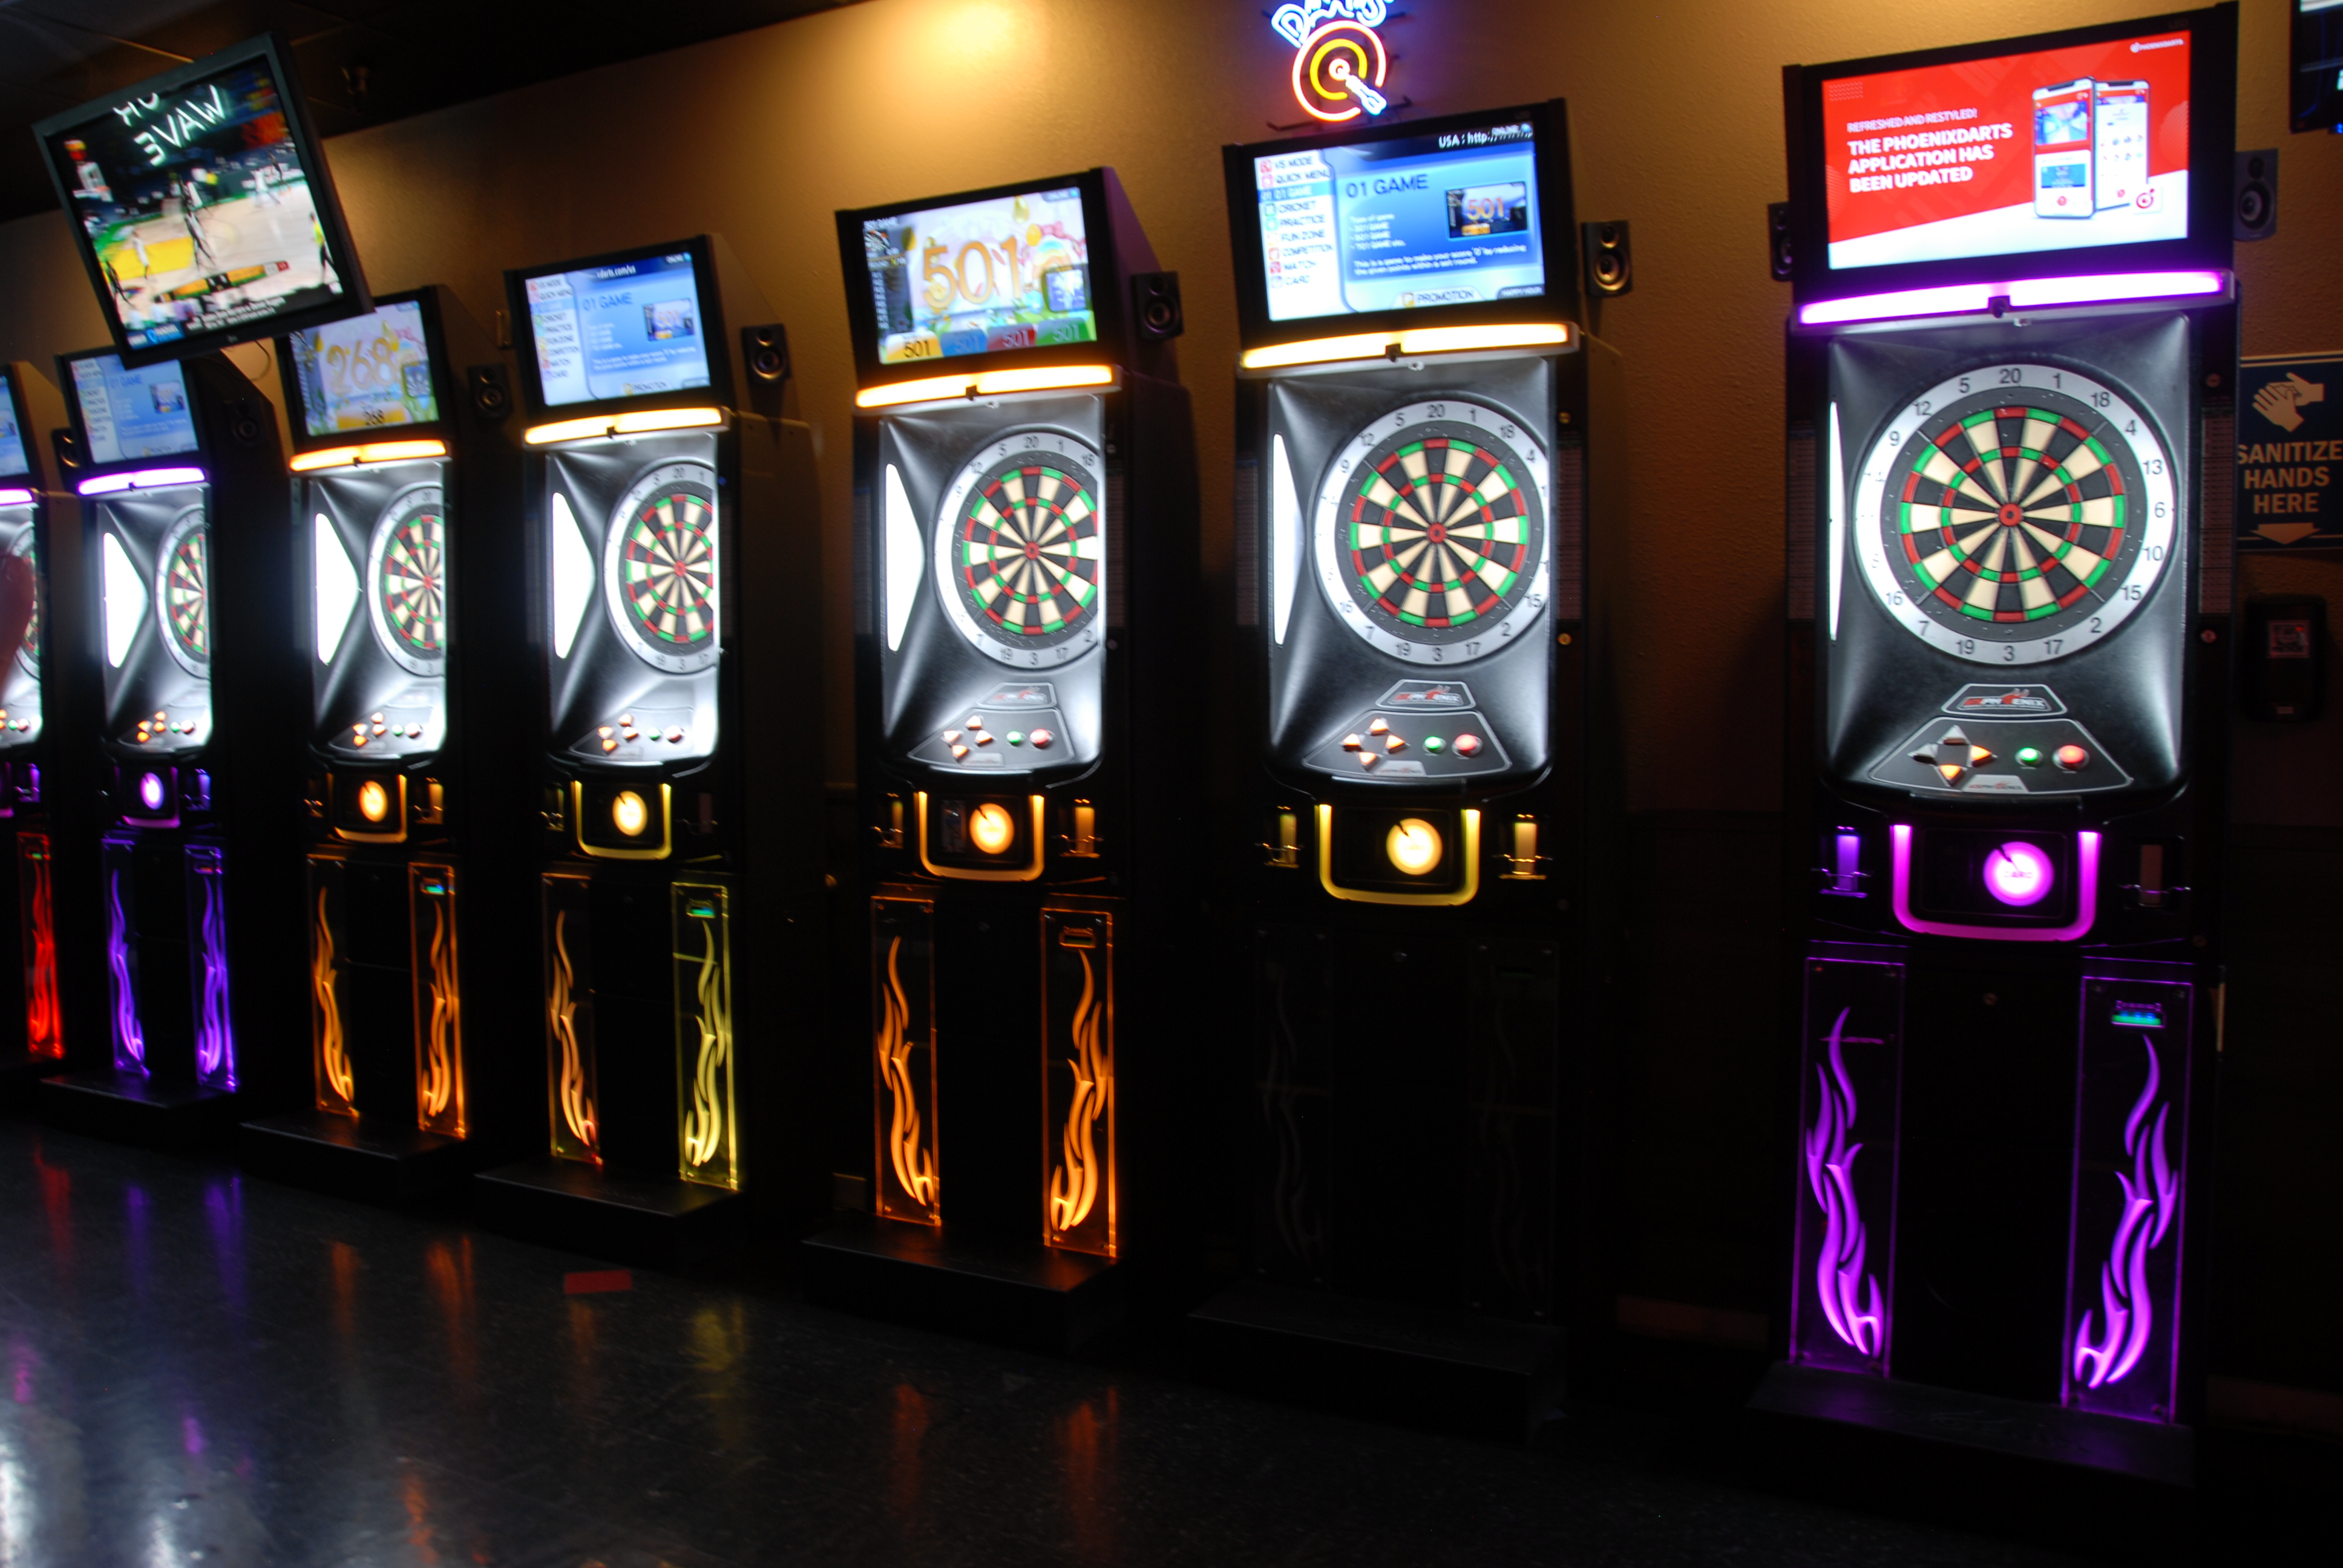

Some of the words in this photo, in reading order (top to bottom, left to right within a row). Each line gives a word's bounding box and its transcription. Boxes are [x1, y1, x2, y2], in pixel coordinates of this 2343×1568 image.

[1847, 117, 1904, 132] REFRESHED
[1904, 115, 1925, 126] AND
[1925, 108, 1978, 123] RESTYLED!
[1439, 134, 1460, 149] USA
[1847, 138, 1882, 155] THE
[1883, 122, 2013, 152] PHOENIXDARTS
[1848, 148, 1956, 174] APPLICATION
[1959, 144, 1994, 162] HAS
[1346, 181, 1368, 198] 01
[1373, 174, 1429, 195] GAME
[1849, 174, 1893, 193] BEEN
[1895, 166, 1973, 188] UPDATED
[1279, 201, 1317, 214] CRICKET
[1467, 197, 1504, 221] 501
[1280, 214, 1325, 226] PRACTICE
[1283, 244, 1333, 256] COMPETITION
[922, 235, 1021, 309] 501
[582, 298, 597, 312] 01
[600, 292, 634, 309] GAME
[1418, 290, 1473, 302] PROMOTION
[1003, 329, 1029, 348] 501
[1053, 324, 1080, 342] 501
[903, 340, 931, 358] 501
[327, 337, 396, 394] 268
[1999, 368, 2021, 384] 20
[2053, 373, 2061, 388] 1
[1959, 378, 1970, 393] 5
[2091, 391, 2111, 407] 18
[1427, 404, 1445, 417] 20
[1470, 408, 1477, 422] 1
[1913, 402, 1932, 417] 12
[1395, 413, 1405, 426] 5
[2125, 419, 2137, 436] 4
[1889, 431, 1900, 447] 9
[1526, 449, 1535, 463] 4
[2237, 440, 2343, 464] SANITIZE
[2143, 459, 2163, 474] 13
[2244, 466, 2330, 489] HANDS
[2154, 501, 2166, 518] 6
[2253, 492, 2319, 514] HERE
[2143, 546, 2164, 562] 10
[2122, 584, 2142, 601] 15
[1365, 626, 1375, 640] 7
[1501, 622, 1511, 636] 2
[1919, 621, 1930, 636] 7
[2089, 617, 2102, 634] 2
[1432, 648, 1443, 662] 3
[1465, 642, 1481, 656] 17
[1956, 639, 1976, 655] 19
[2003, 645, 2016, 661] 3
[2043, 639, 2063, 655] 17
